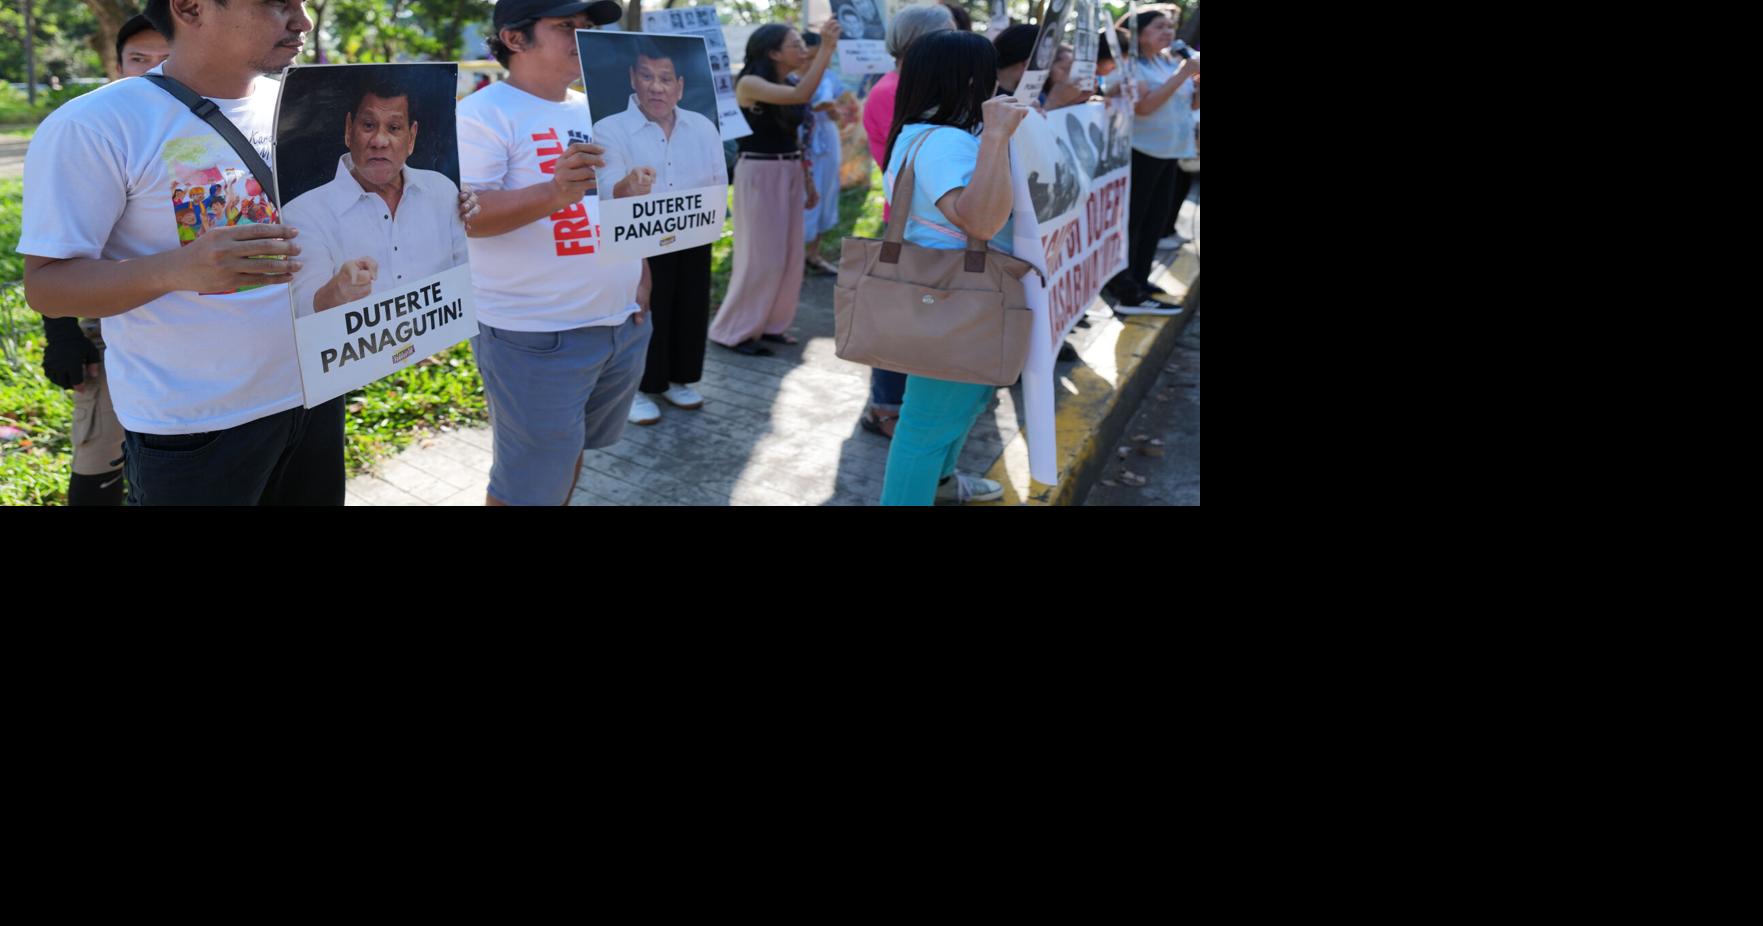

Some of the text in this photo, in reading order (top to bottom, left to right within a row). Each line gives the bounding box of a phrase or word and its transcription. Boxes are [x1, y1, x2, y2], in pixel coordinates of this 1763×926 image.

[531, 127, 565, 174] ALL
[614, 209, 716, 242] PANAGUTIN!
[633, 193, 702, 219] DUTERTE
[344, 281, 443, 335] DUTERTE
[320, 298, 463, 373] PANAGUTIN!
